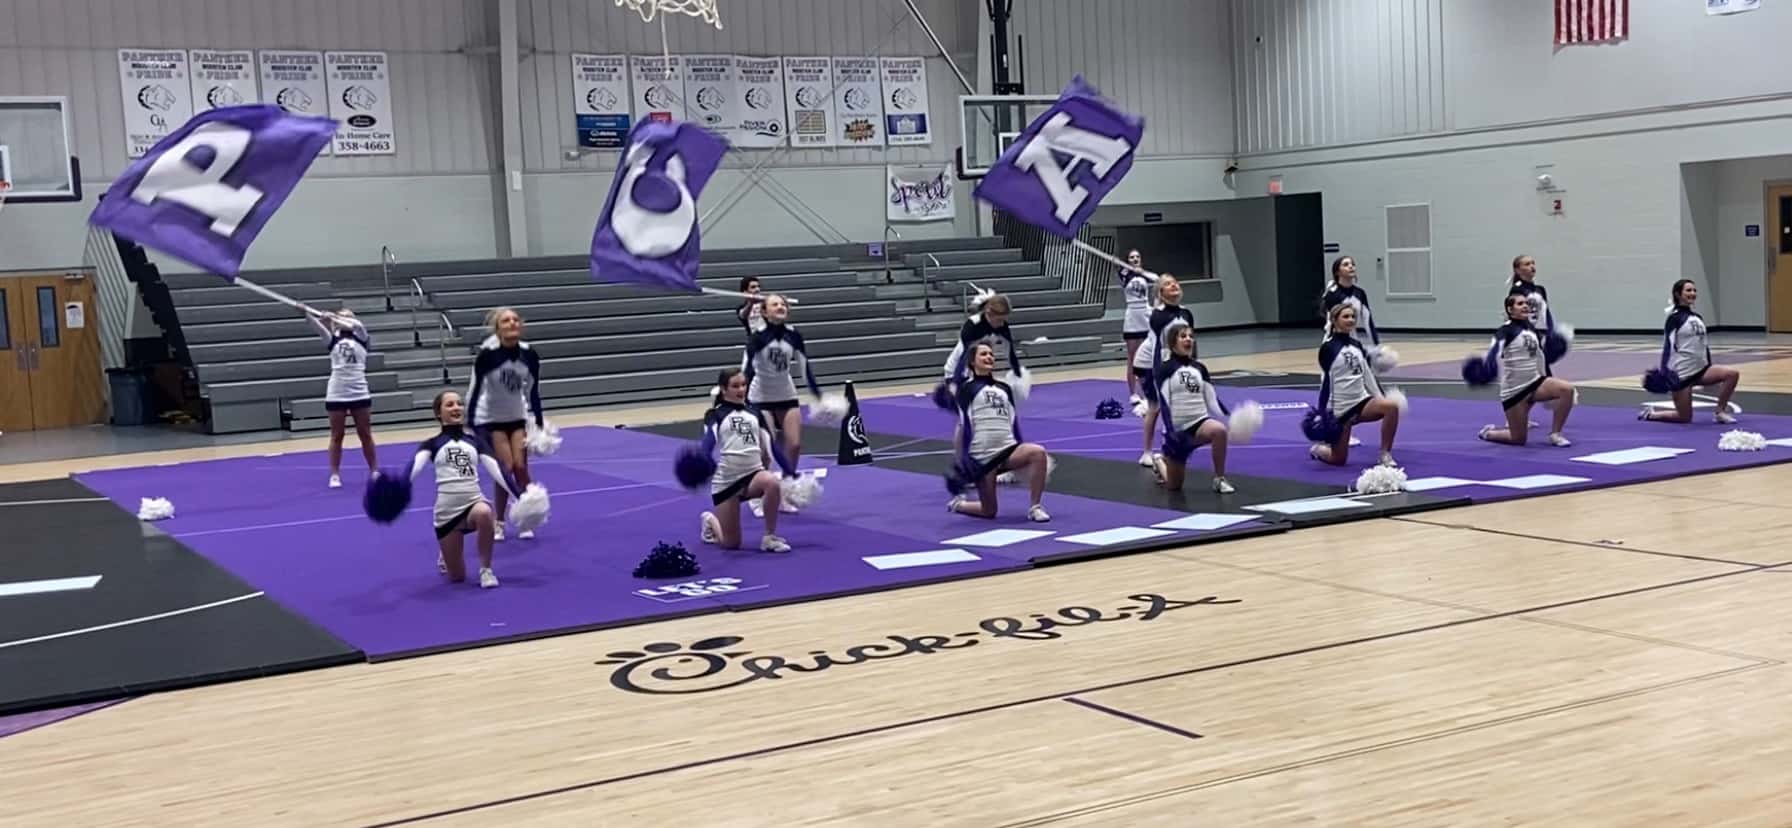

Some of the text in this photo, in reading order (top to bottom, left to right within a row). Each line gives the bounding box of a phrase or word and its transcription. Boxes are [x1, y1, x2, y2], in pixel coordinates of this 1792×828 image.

[338, 141, 390, 151] 358-4663
[372, 131, 391, 139] Care
[1014, 111, 1131, 224] A
[131, 120, 264, 237] P
[611, 142, 695, 259] C
[446, 447, 475, 477] PCA
[730, 416, 757, 445] PCA
[598, 593, 1243, 694] Chick-fil-A
